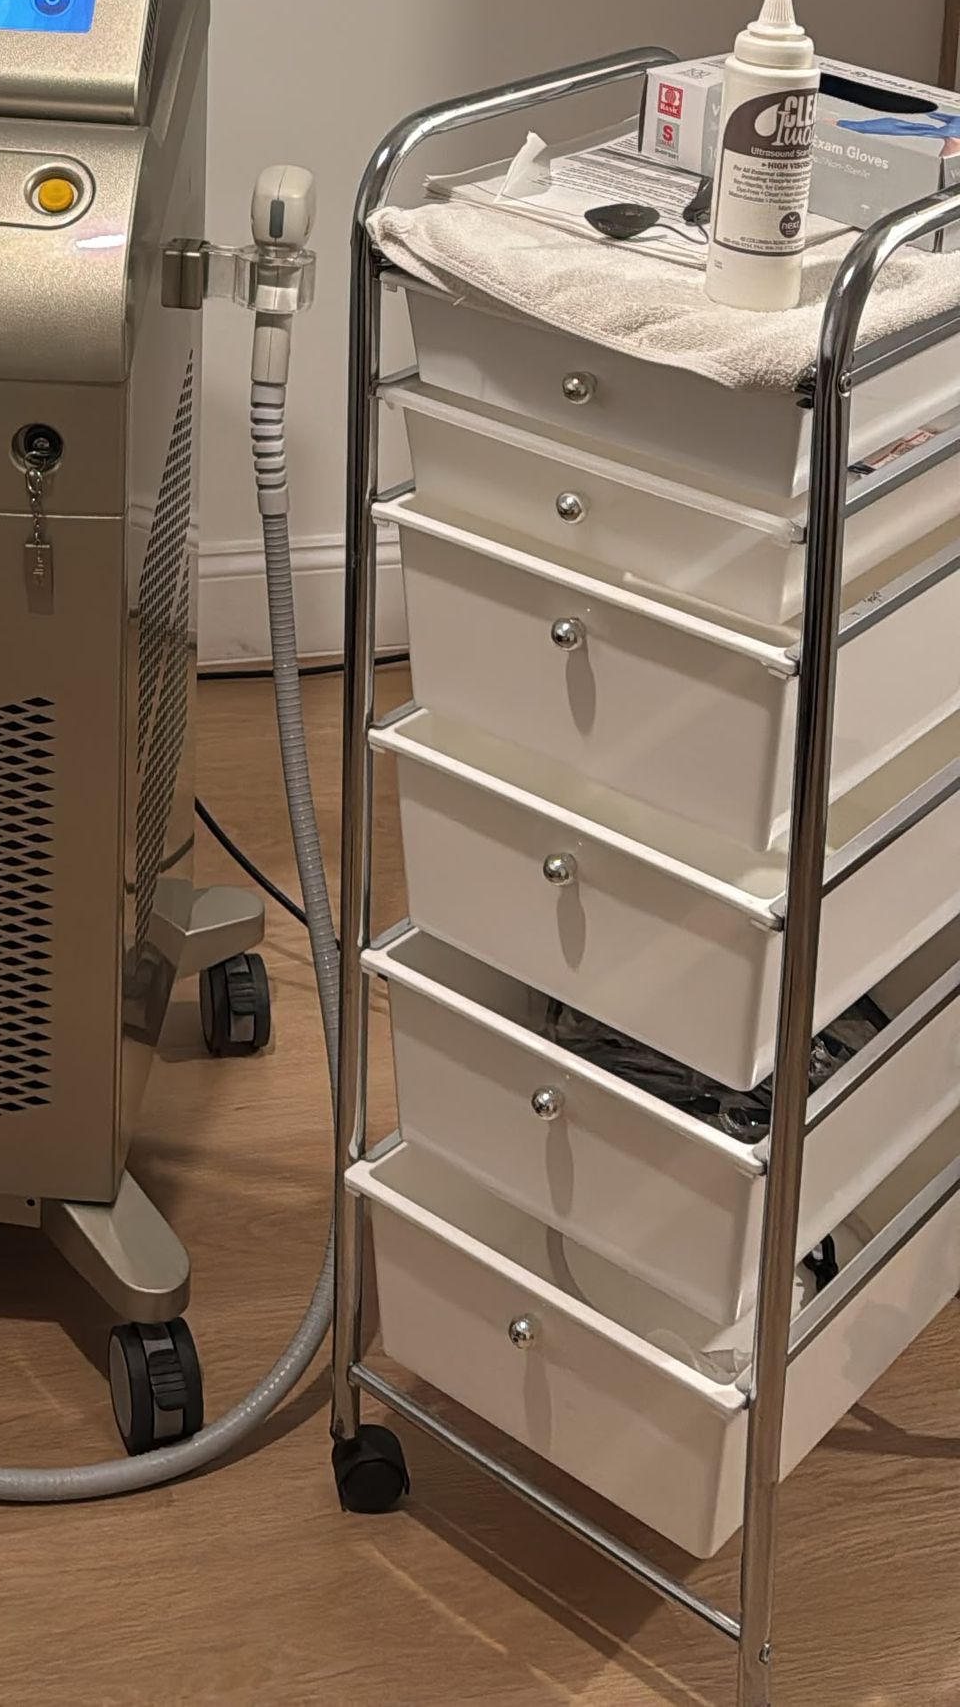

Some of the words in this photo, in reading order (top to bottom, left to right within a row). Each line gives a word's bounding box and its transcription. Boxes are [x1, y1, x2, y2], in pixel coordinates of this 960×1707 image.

[783, 95, 817, 128] CLE
[662, 124, 674, 142] S
[771, 111, 816, 146] Ima
[750, 146, 795, 158] Ultrasound
[811, 135, 843, 156] Exam
[846, 145, 889, 170] Gloves
[767, 161, 789, 170] HIGH
